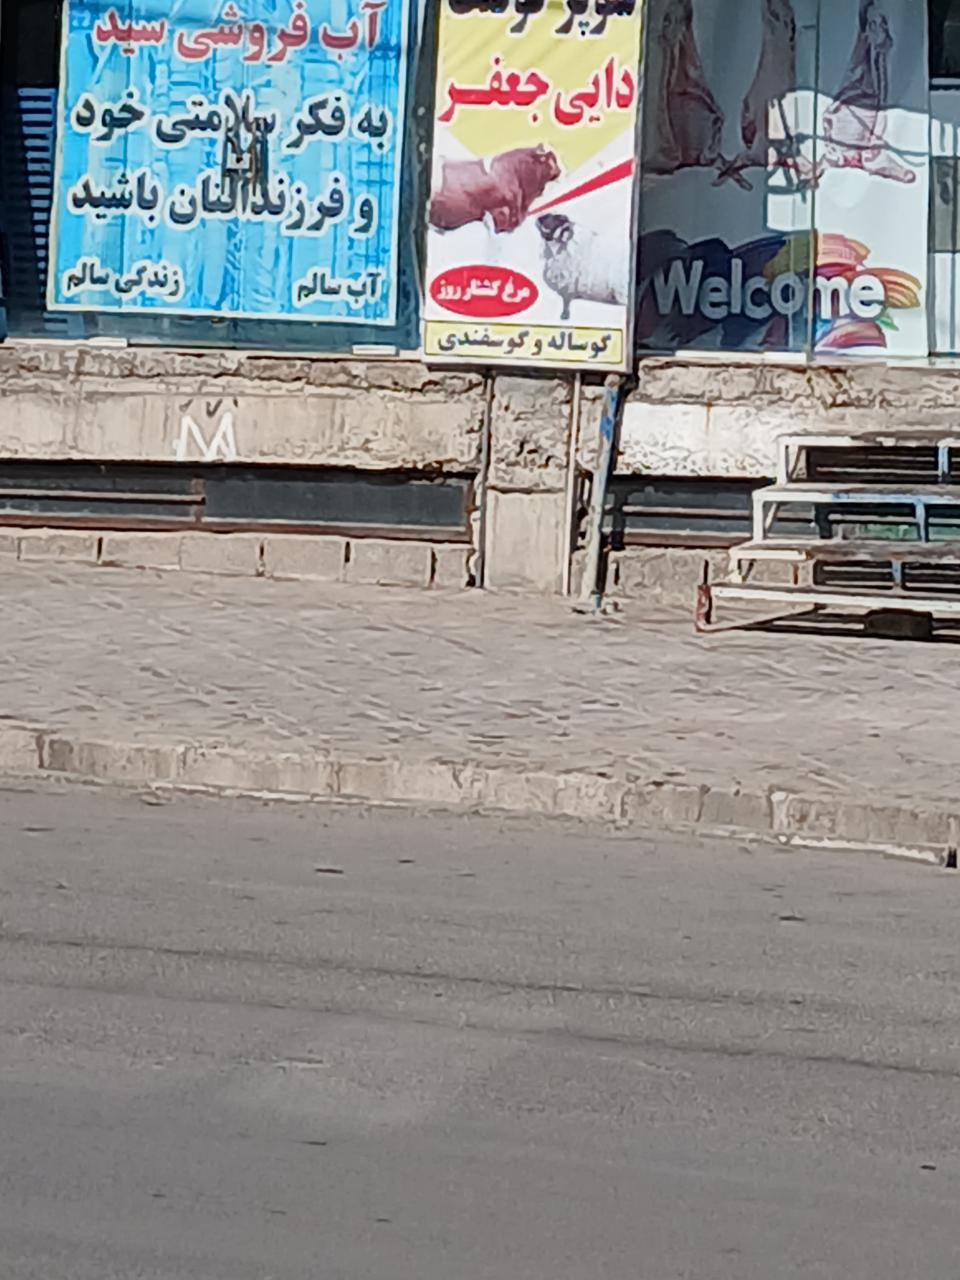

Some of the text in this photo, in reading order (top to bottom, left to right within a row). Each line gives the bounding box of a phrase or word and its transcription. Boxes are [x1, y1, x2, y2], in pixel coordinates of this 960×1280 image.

[94, 1, 388, 62] آب فروشی سید
[438, 57, 635, 125] دایی جعفر
[74, 87, 389, 150] به فکر سلامتی خود
[71, 172, 159, 223] باشید
[355, 196, 376, 233] و
[66, 263, 181, 297] زندگی سالم
[297, 271, 383, 303] آب سالم
[501, 275, 531, 303] مرغ
[652, 257, 888, 322] Welcome
